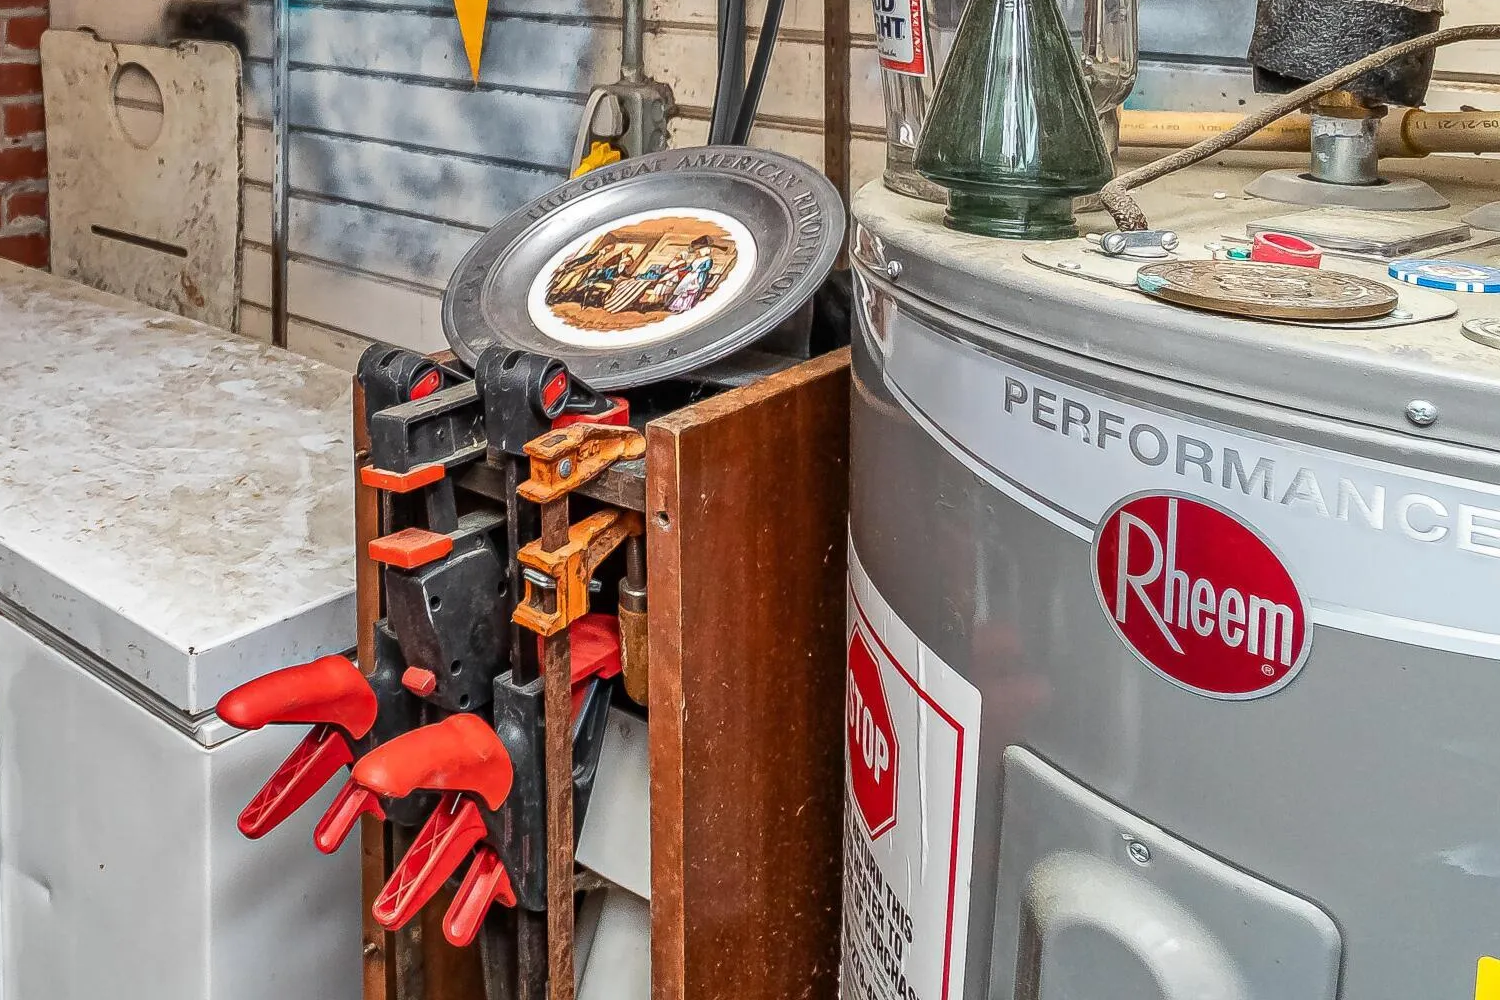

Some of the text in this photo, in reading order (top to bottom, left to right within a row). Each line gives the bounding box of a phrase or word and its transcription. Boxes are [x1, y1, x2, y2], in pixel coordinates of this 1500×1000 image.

[524, 154, 823, 305] THE GREAT AMERICAN REVOLUTION
[1004, 376, 1500, 558] PERFORMANCE
[1115, 497, 1295, 667] Rheem
[848, 669, 889, 784] STOP
[885, 881, 914, 944] THIS
[887, 918, 903, 962] TO
